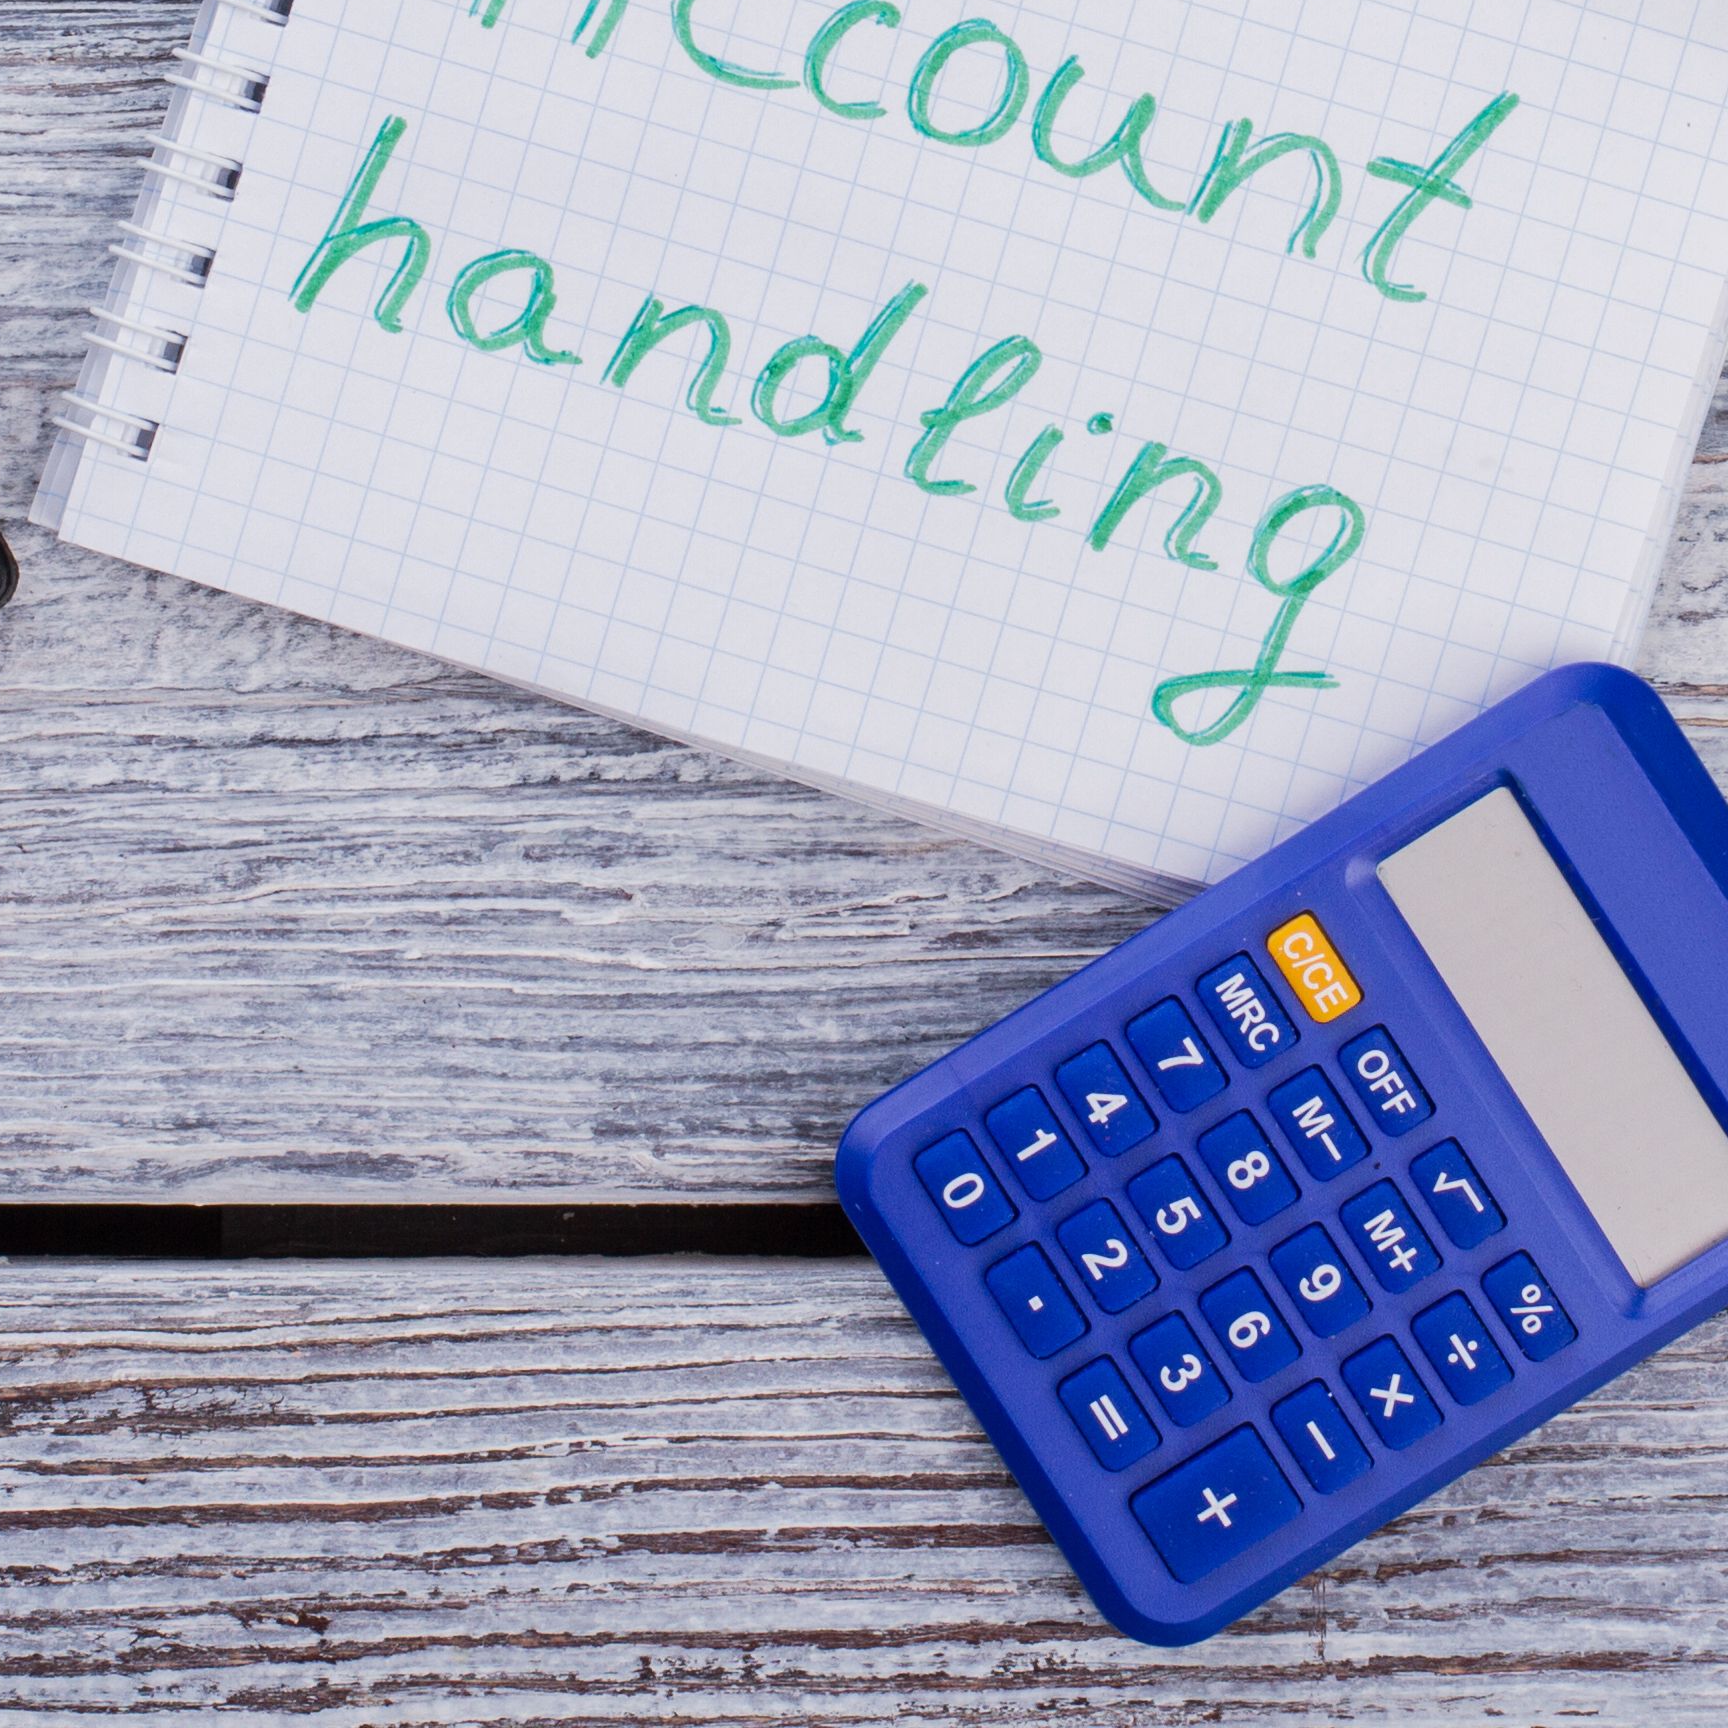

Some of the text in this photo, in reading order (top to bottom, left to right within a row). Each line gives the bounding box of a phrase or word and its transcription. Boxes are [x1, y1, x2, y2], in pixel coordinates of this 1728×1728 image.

[289, 115, 1365, 745] handling
[1283, 931, 1349, 1014] C/CE
[1215, 971, 1282, 1052] MRC
[1157, 1036, 1204, 1071] 7
[1357, 1049, 1417, 1114] OFF
[1086, 1092, 1128, 1124] 4
[1017, 1128, 1058, 1161] 1
[1227, 1150, 1270, 1190] 8
[943, 1172, 985, 1209] 0
[1156, 1196, 1202, 1234] 5
[1081, 1238, 1128, 1281] 2
[1363, 1209, 1417, 1272] M+
[1299, 1264, 1342, 1302] 9
[1510, 1284, 1554, 1334] %
[1228, 1311, 1271, 1349] 6
[1160, 1353, 1202, 1392] 3
